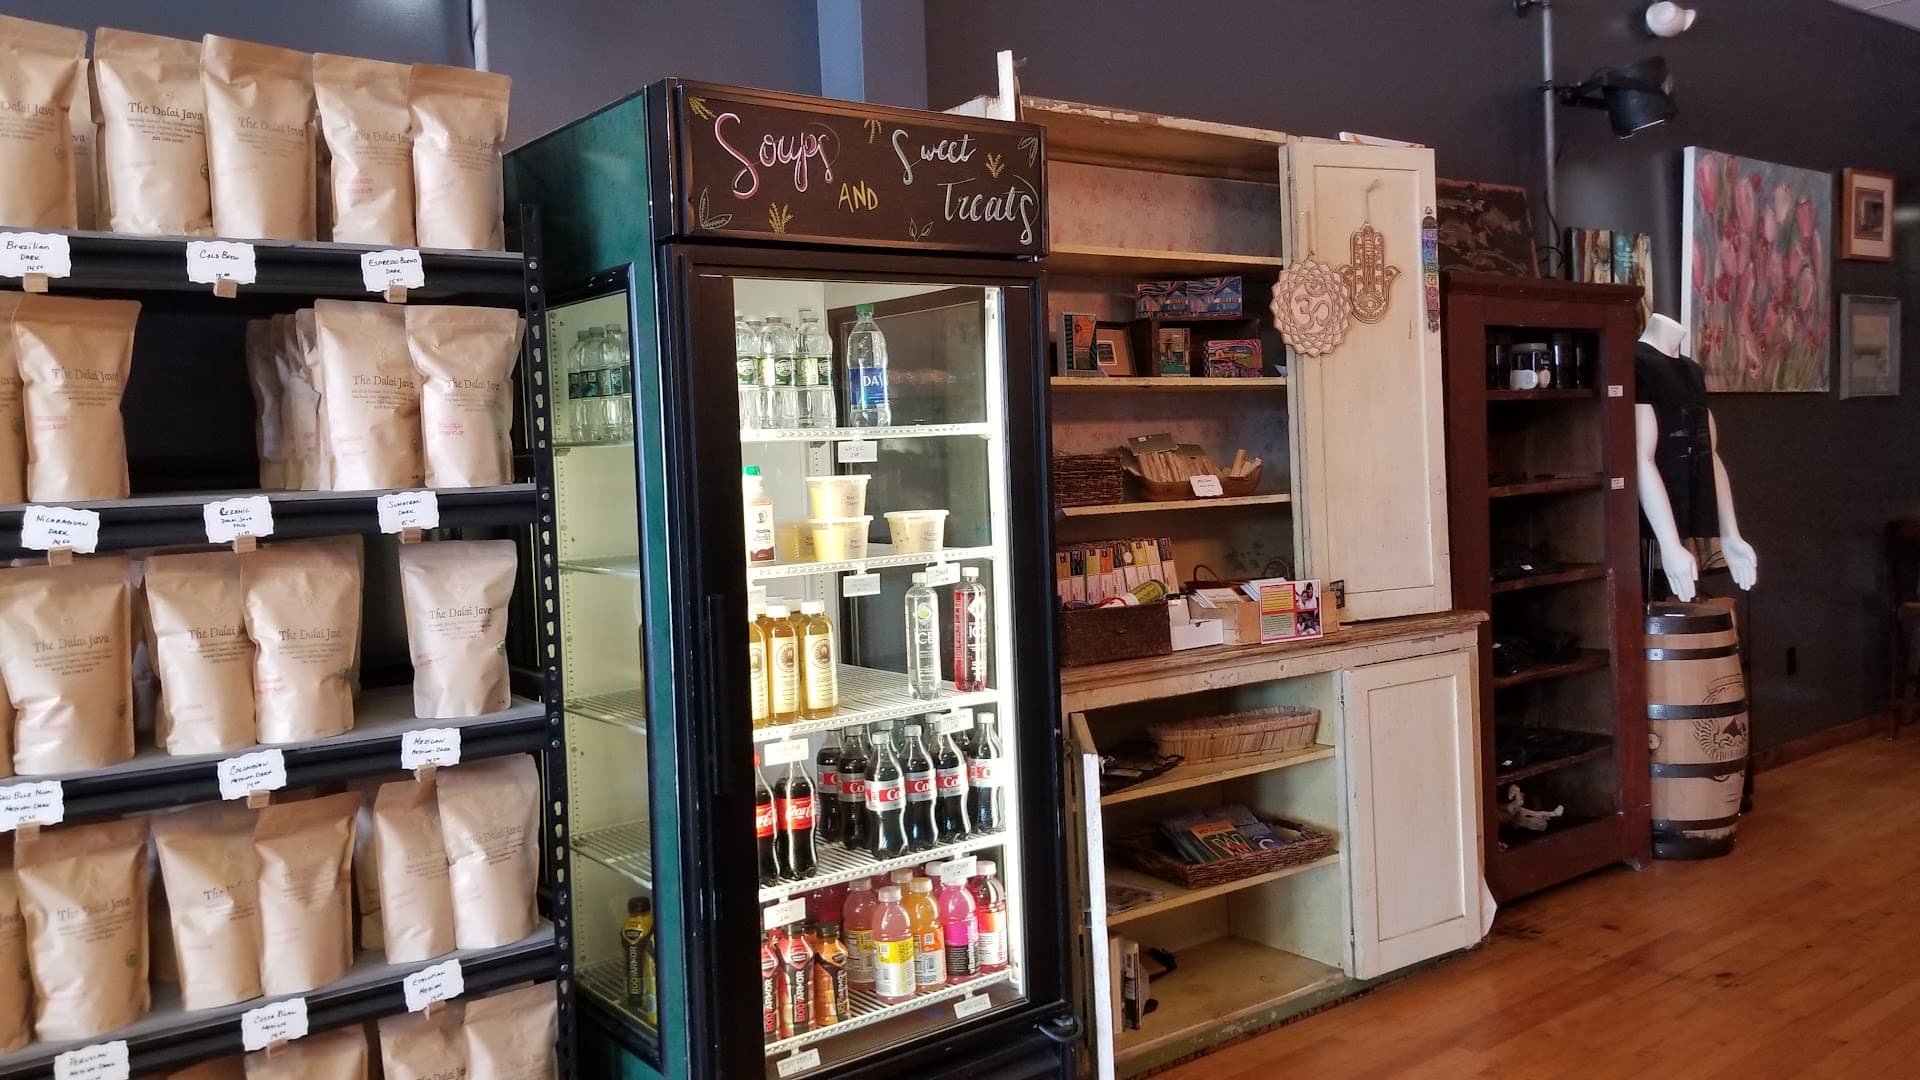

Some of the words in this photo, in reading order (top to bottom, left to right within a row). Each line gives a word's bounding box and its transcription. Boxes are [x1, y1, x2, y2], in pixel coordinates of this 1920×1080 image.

[127, 102, 149, 114] The
[152, 105, 180, 119] Dalai
[182, 108, 204, 121] Java
[714, 113, 836, 200] Soups
[892, 129, 977, 186] Sweet
[838, 180, 879, 213] AND
[936, 175, 1040, 246] Treats
[6, 240, 50, 251] Brazilian
[20, 254, 40, 262] DARK
[353, 375, 371, 386] The
[398, 377, 415, 390] Java
[48, 528, 69, 536] DARK
[429, 607, 447, 620] The
[187, 626, 208, 641] The
[278, 628, 298, 641] The
[32, 639, 54, 654] The
[795, 970, 806, 1023] BODYARMOR
[763, 977, 775, 1034] BODYARMOR
